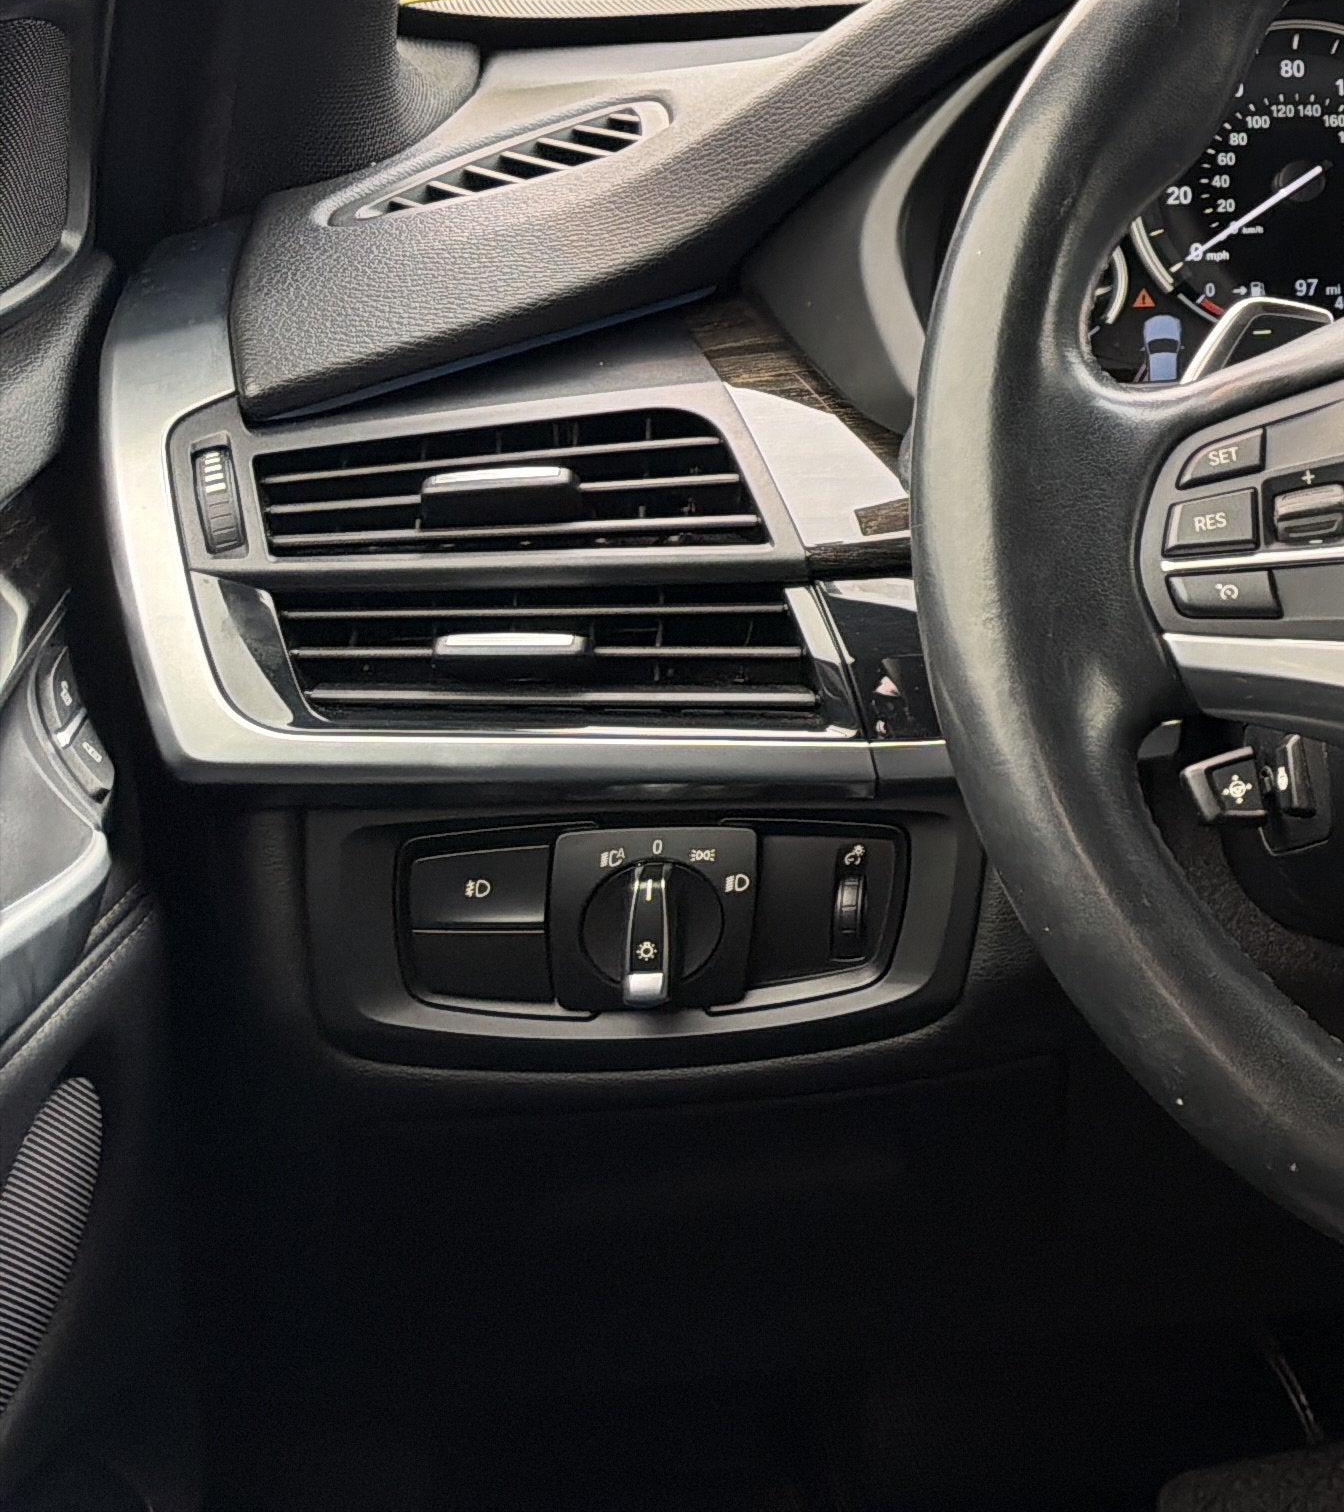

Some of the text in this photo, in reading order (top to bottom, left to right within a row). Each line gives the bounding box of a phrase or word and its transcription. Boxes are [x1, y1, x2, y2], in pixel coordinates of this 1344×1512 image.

[1280, 59, 1304, 78] 80
[1271, 104, 1294, 116] 120
[1298, 104, 1321, 116] 140
[1246, 115, 1270, 128] 100
[1230, 131, 1247, 144] 80
[1218, 152, 1235, 164] 60
[1213, 174, 1230, 187] 40
[1167, 186, 1192, 204] 20
[1217, 199, 1235, 211] 20
[1206, 249, 1229, 262] mph
[1205, 283, 1215, 296] 0
[1295, 279, 1341, 295] 97 mi
[1208, 446, 1238, 466] SET
[1194, 512, 1227, 532] RES
[652, 840, 663, 856] 0
